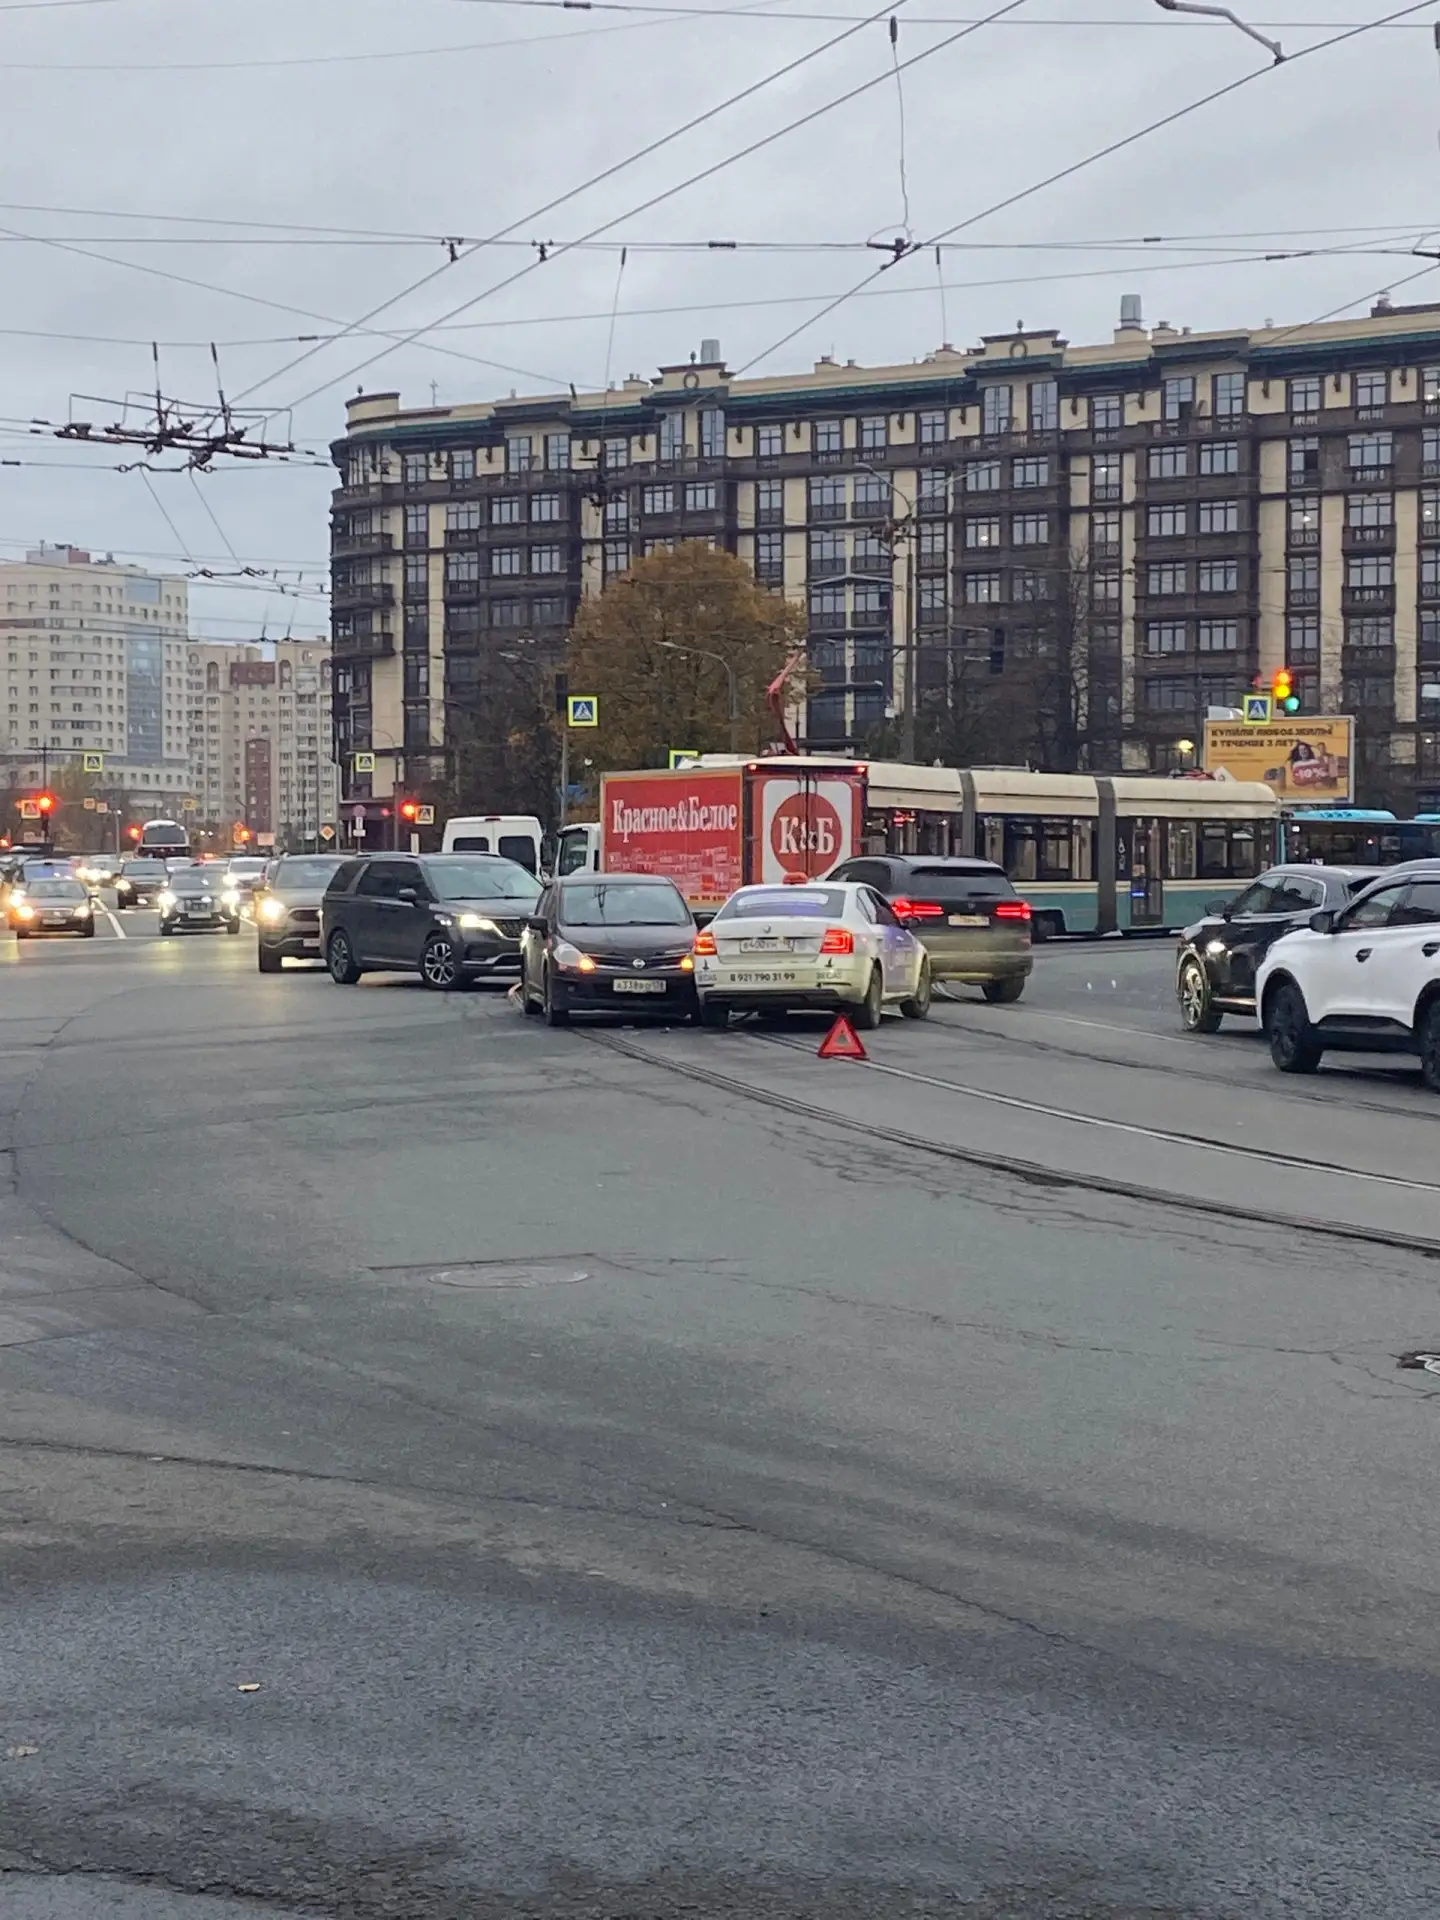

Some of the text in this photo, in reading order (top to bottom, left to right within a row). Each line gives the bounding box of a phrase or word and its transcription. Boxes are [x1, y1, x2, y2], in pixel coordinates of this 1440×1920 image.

[612, 796, 737, 843] Красное&Белое
[779, 816, 834, 854] К&Б
[730, 972, 795, 982] 8 921 790 31 99
